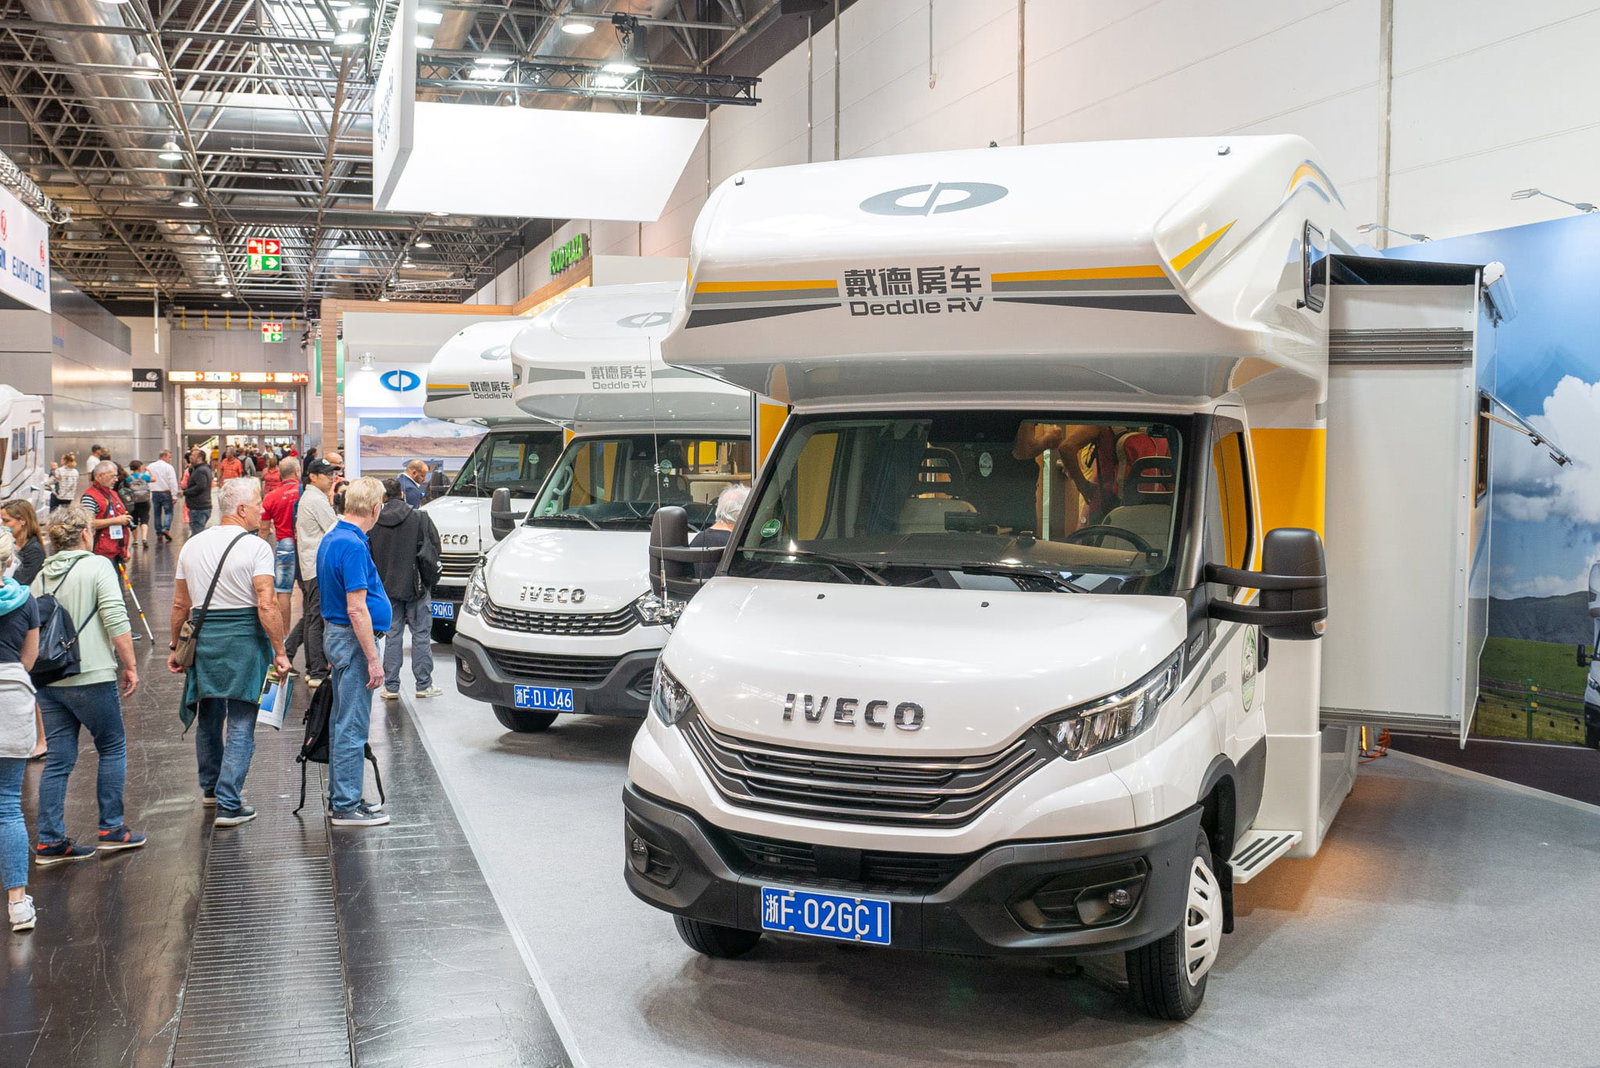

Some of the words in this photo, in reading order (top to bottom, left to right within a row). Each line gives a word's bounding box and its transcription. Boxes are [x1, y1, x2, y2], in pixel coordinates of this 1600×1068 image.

[844, 265, 982, 297] 戴德房车
[850, 298, 941, 316] Deddle
[947, 296, 984, 313] RV
[591, 365, 647, 380] 戴德房车
[592, 381, 630, 390] Deddle
[631, 380, 648, 389] RV
[439, 534, 468, 545] ECO
[520, 586, 586, 604] IVECO
[782, 693, 925, 731] IVECO
